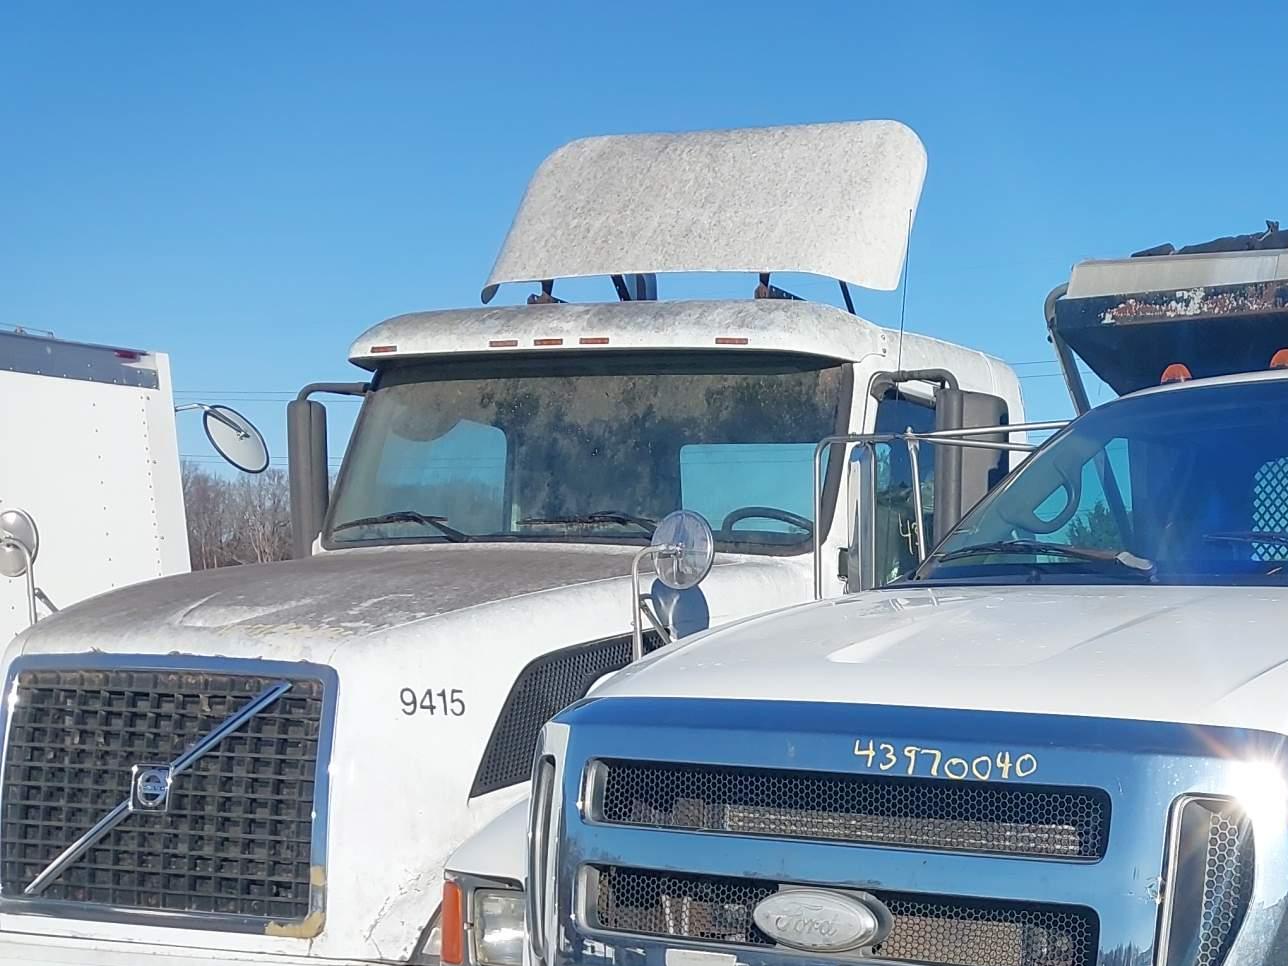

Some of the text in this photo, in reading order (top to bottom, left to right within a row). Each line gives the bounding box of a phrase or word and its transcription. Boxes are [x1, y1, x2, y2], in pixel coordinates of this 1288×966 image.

[399, 686, 465, 717] 9415
[854, 740, 1037, 781] 43970040
[768, 903, 838, 937] Ford
